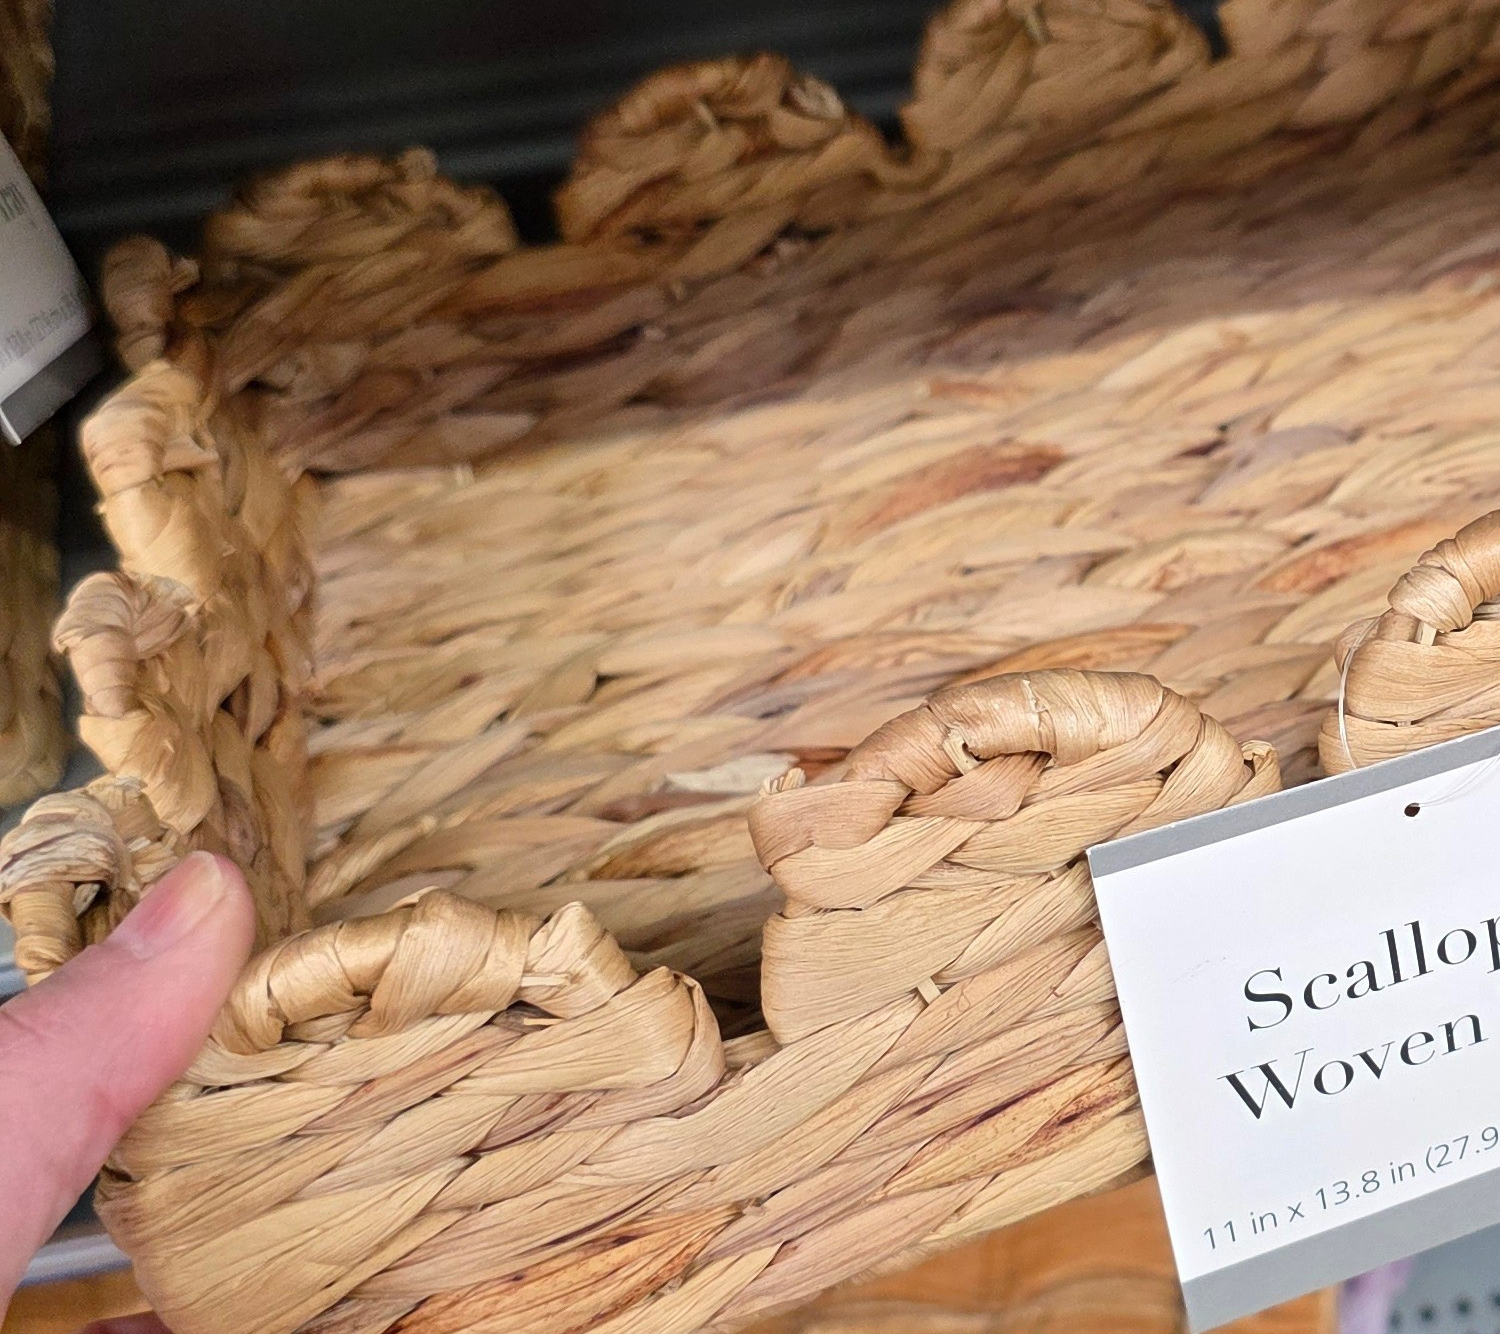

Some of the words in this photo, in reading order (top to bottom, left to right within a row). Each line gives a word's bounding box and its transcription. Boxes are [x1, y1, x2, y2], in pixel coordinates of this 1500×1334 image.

[1216, 1013, 1490, 1120] Woven
[1203, 1220, 1237, 1250] 11
[1250, 1211, 1278, 1235] in
[1287, 1201, 1305, 1223] x
[1315, 1170, 1381, 1210] 13.8
[1389, 1161, 1416, 1185] in
[1425, 1126, 1500, 1174] (27.9
